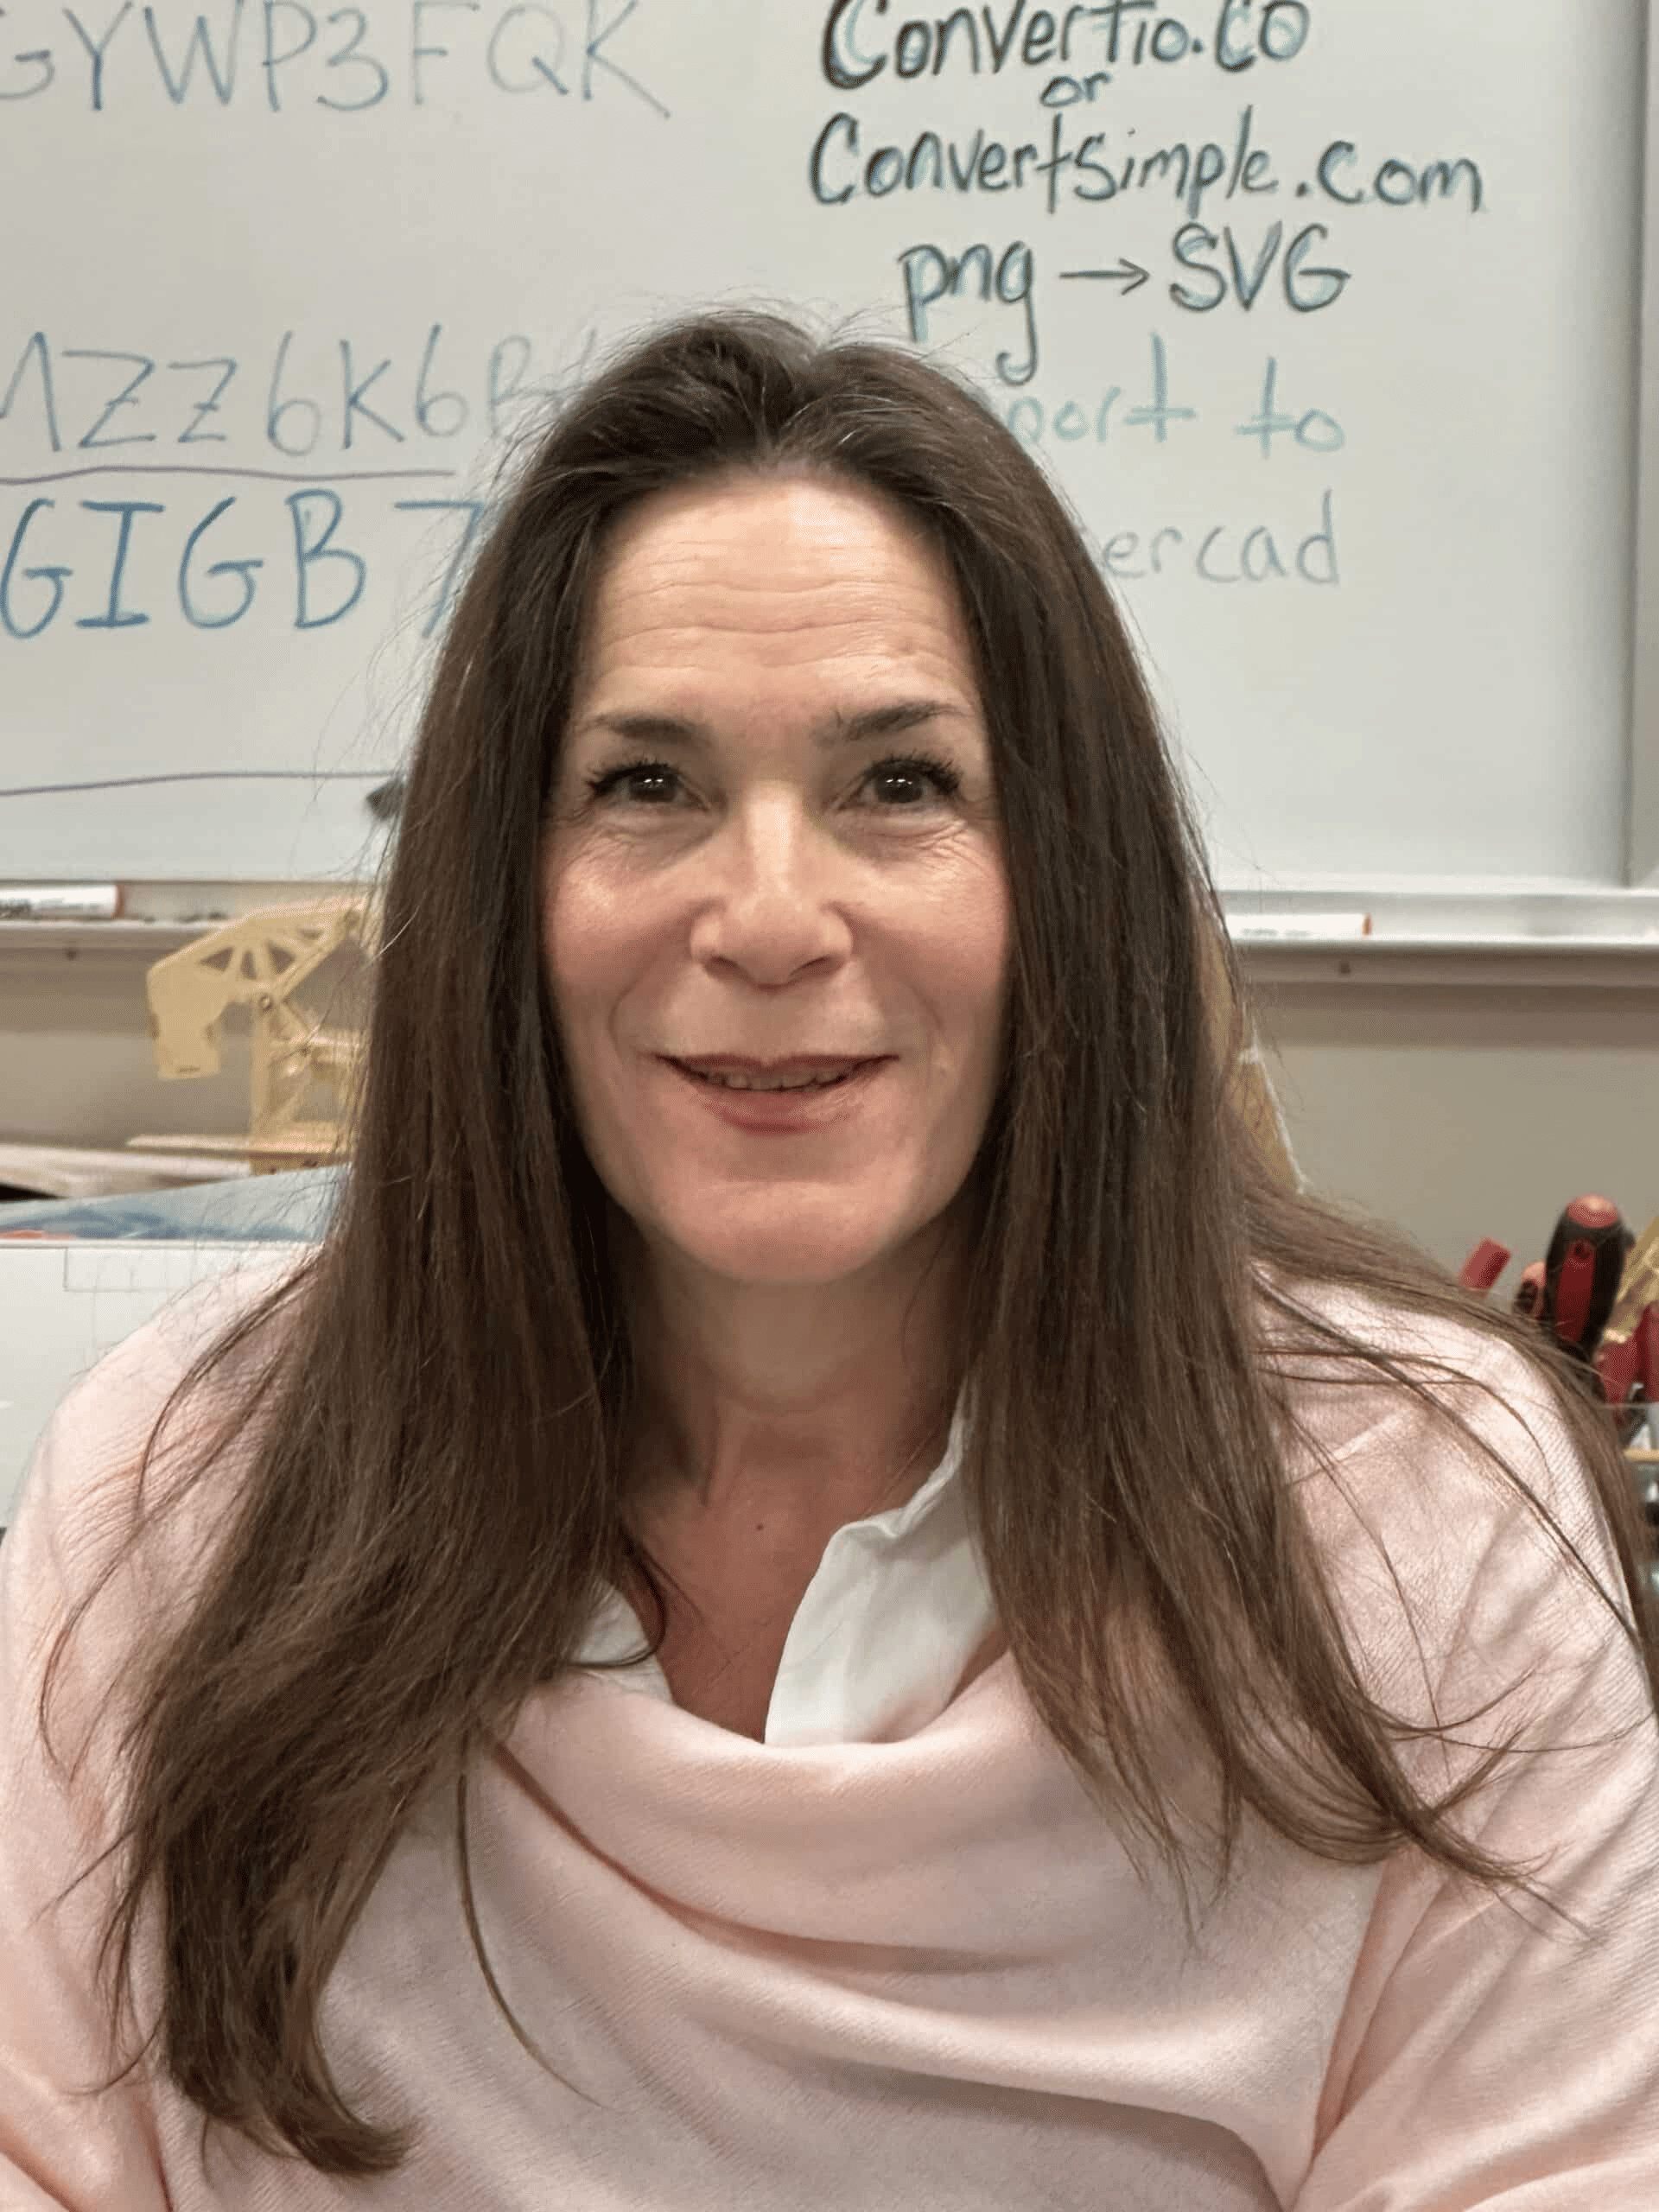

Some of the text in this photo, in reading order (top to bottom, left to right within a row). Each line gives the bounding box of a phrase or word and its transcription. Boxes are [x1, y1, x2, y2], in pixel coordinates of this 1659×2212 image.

[1039, 71, 1112, 108] or
[897, 221, 1352, 387] png SVG
[1236, 356, 1345, 460] to
